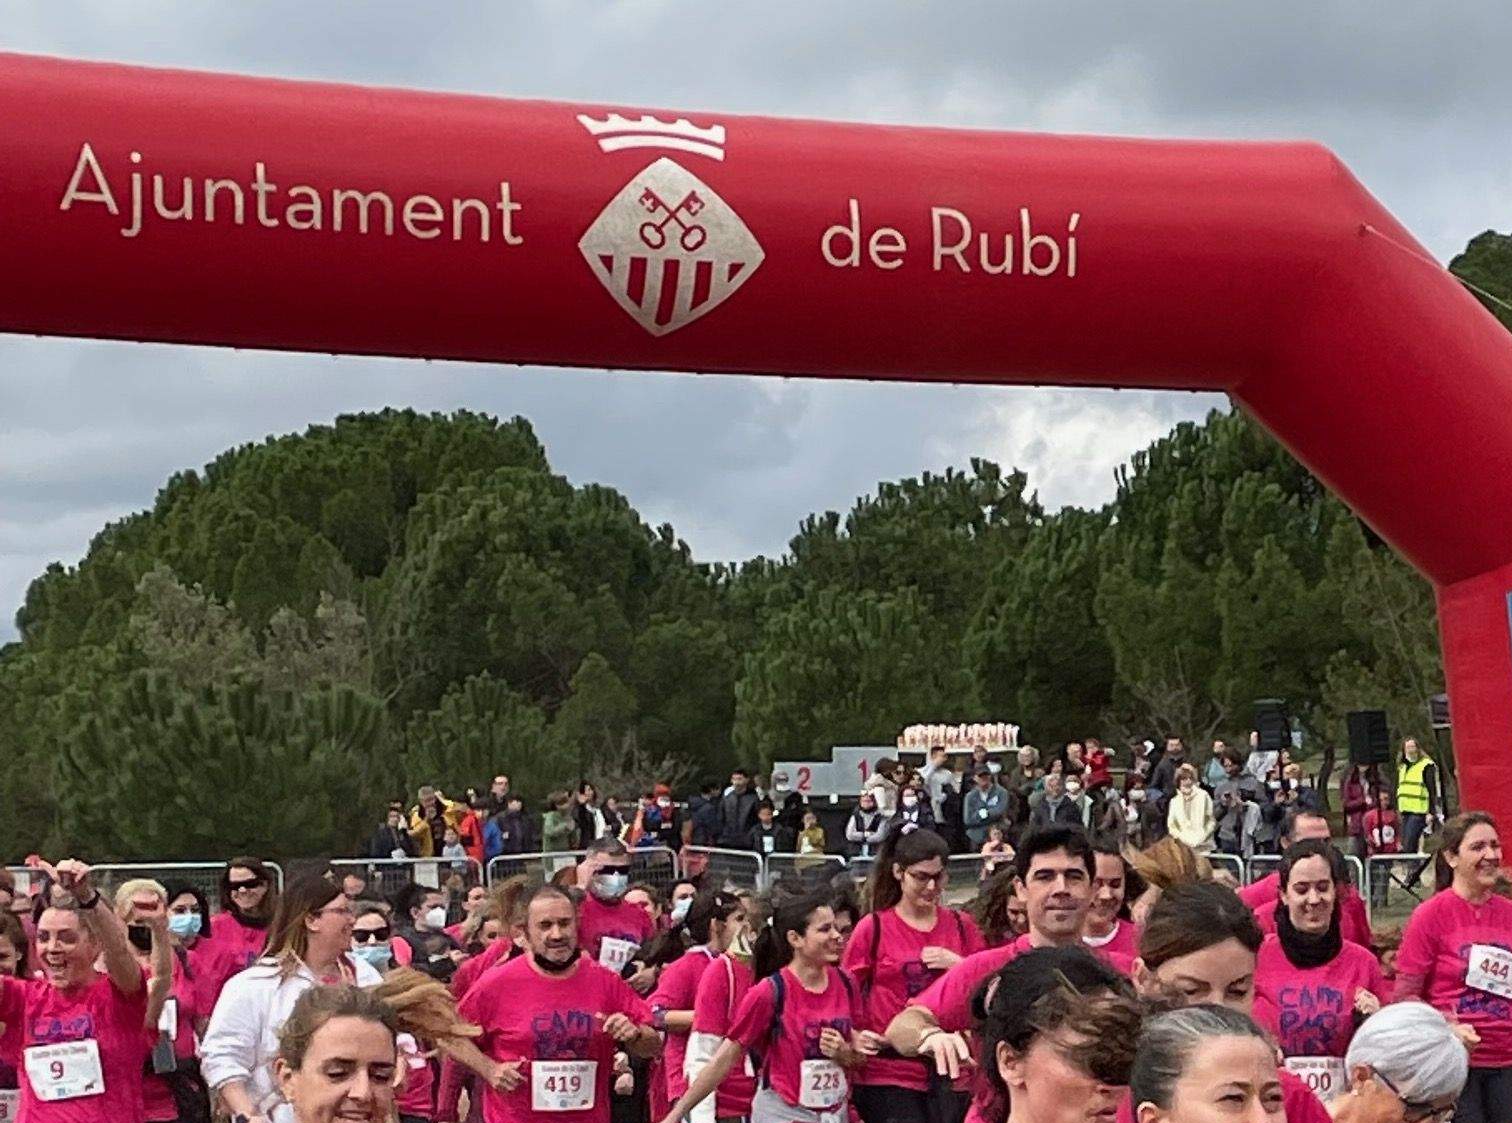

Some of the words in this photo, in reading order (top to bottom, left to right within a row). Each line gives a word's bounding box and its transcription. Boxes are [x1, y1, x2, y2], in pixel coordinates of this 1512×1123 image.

[59, 142, 524, 246] Ajuntament
[820, 198, 907, 270] de
[931, 206, 1081, 278] Rubí
[797, 766, 812, 790] 2
[1480, 958, 1510, 979] 444
[50, 1061, 64, 1080] 9
[545, 1076, 582, 1092] 419
